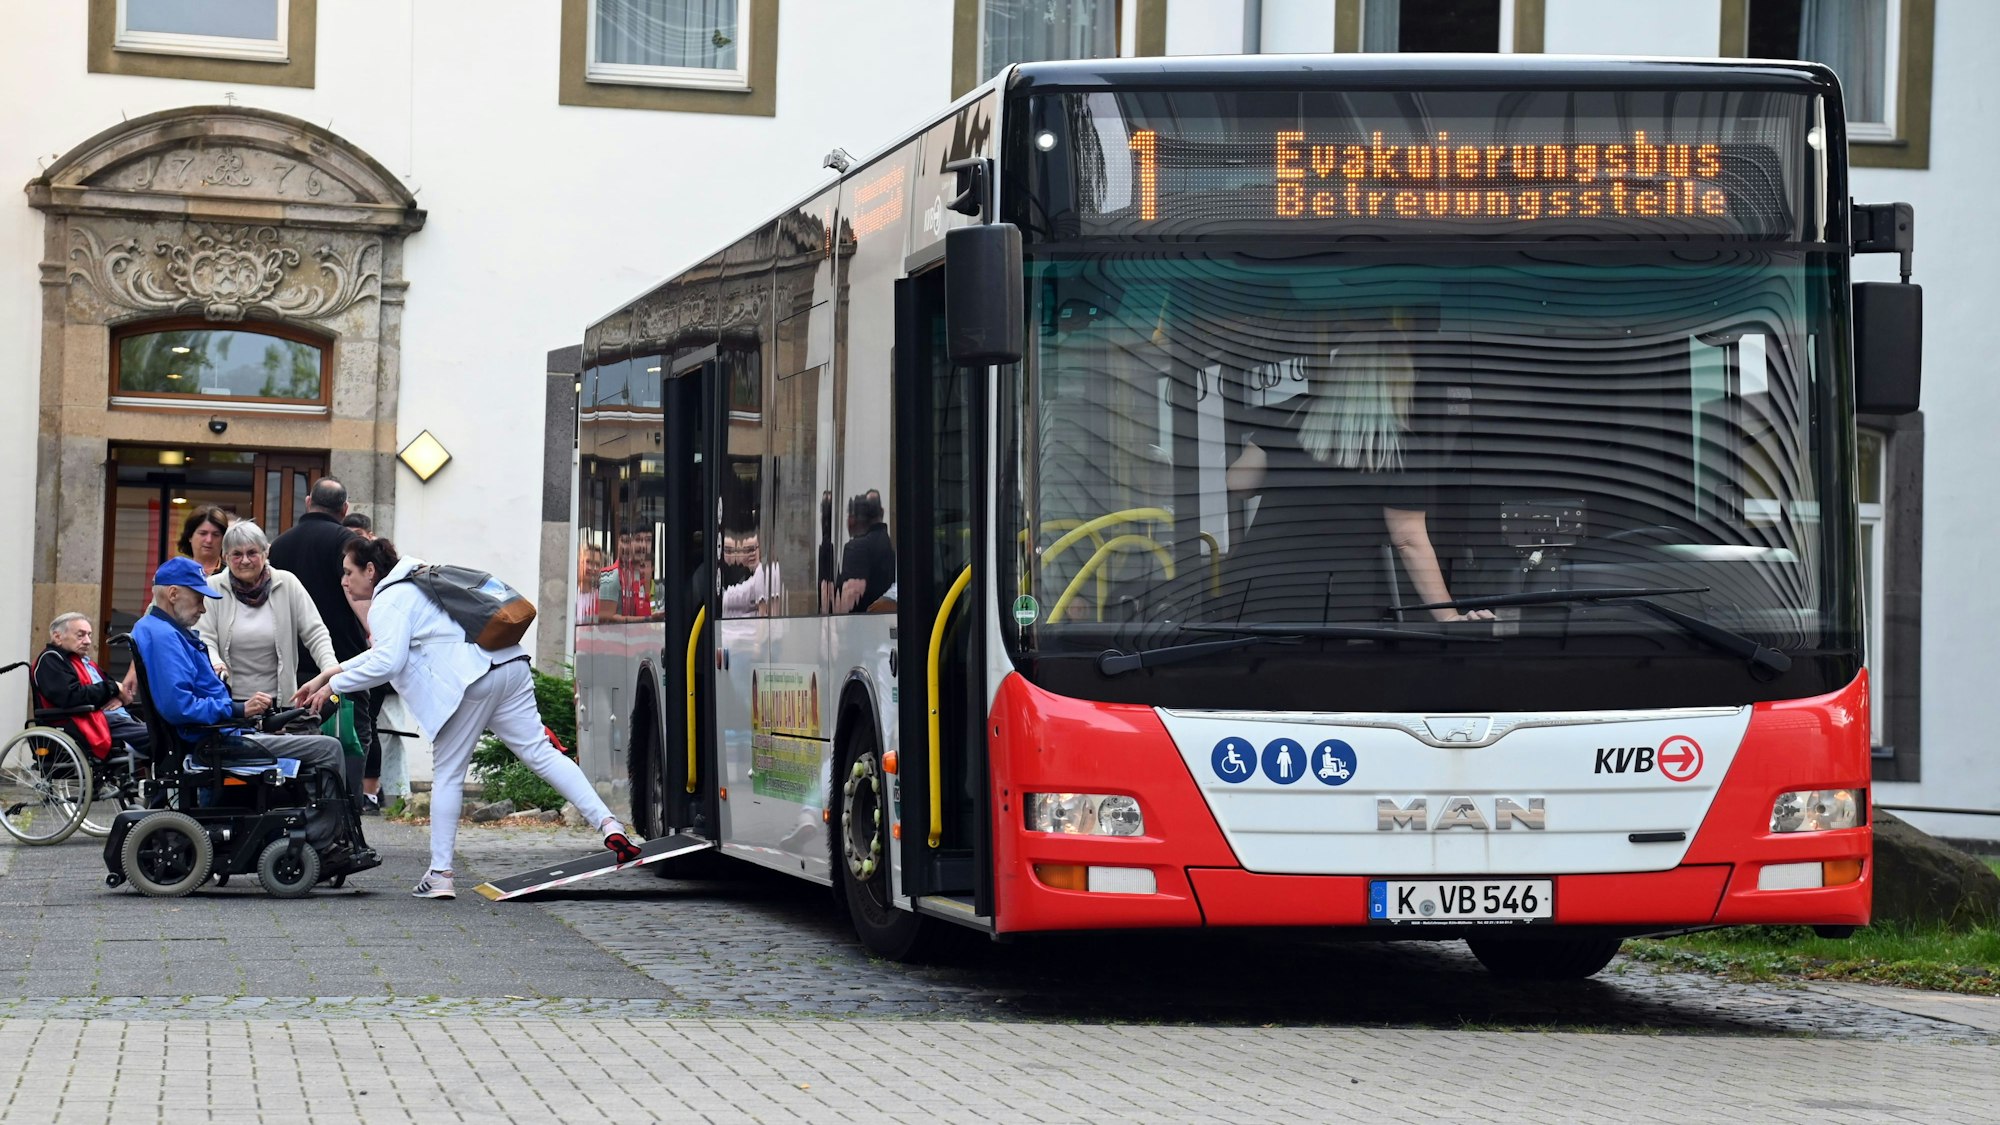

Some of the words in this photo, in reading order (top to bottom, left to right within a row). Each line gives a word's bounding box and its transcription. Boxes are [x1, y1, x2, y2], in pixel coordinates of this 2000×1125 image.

[1277, 130, 1720, 182] Evakuierungsbus
[1128, 131, 1155, 220] 1
[1277, 181, 1725, 220] Betreuungsstelle
[1594, 747, 1655, 774] KVB
[1376, 796, 1546, 831] MAN
[1374, 903, 1382, 913] D
[1398, 886, 1416, 915] K
[1439, 885, 1476, 914] VB
[1483, 885, 1538, 914] 546
